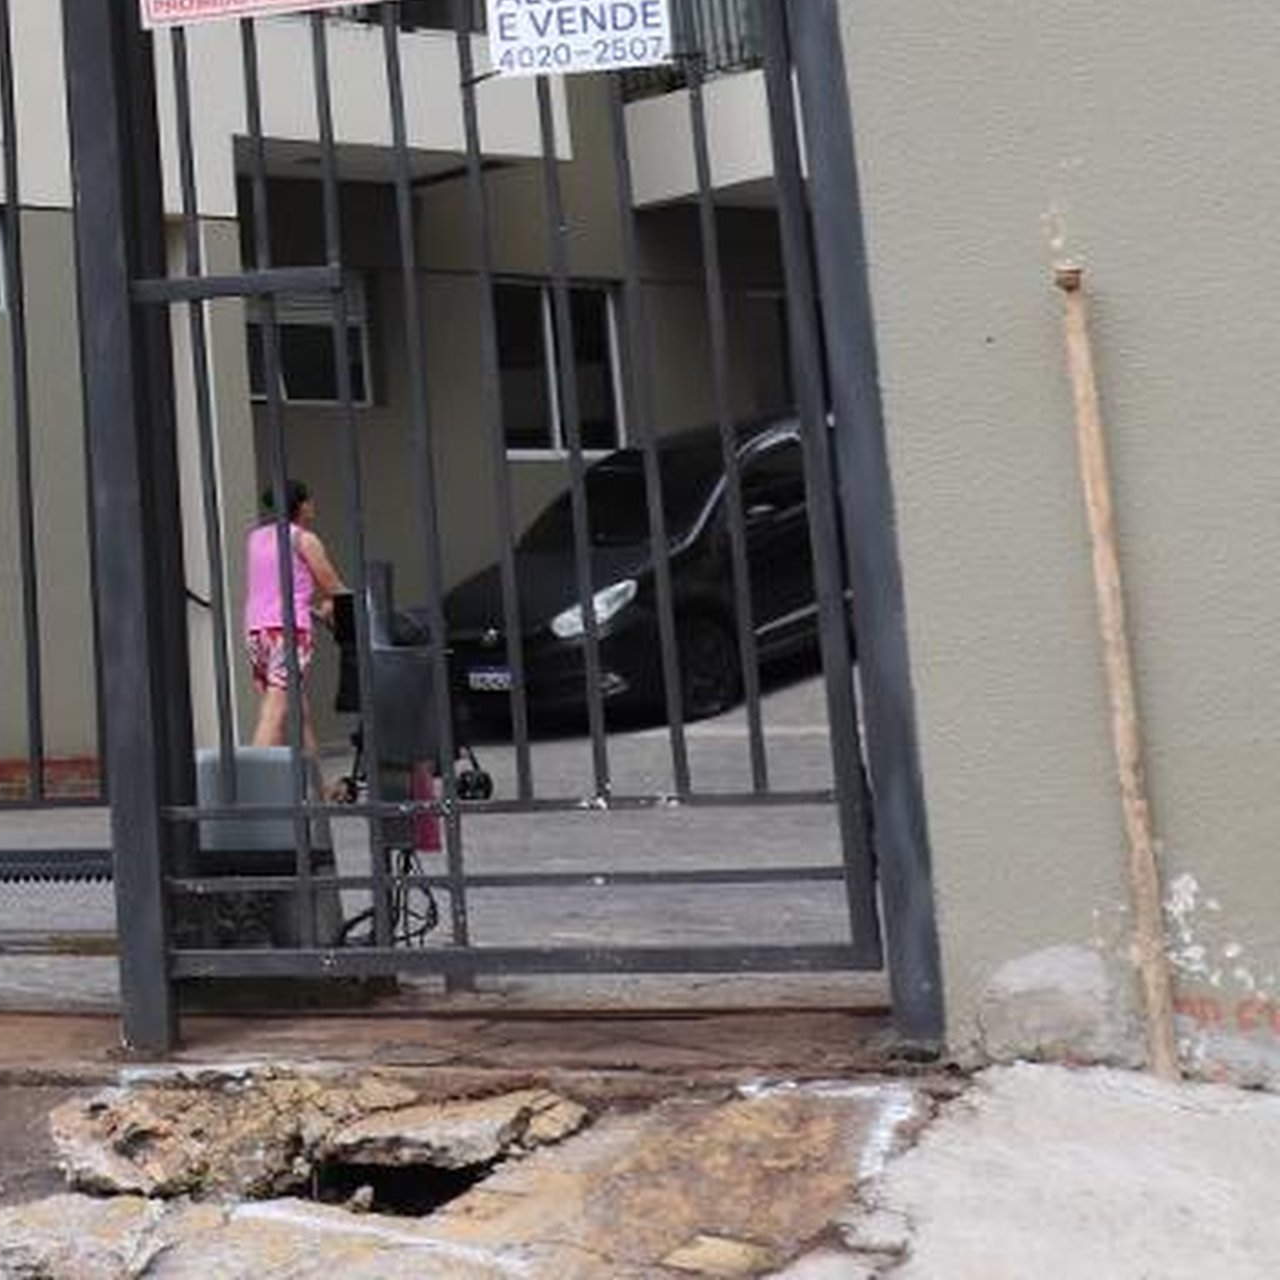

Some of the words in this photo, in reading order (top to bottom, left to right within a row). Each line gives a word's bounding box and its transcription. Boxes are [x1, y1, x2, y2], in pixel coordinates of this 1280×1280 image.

[498, 13, 517, 41] E
[529, 0, 662, 37] VENDE
[500, 36, 663, 69] 4020-2507
